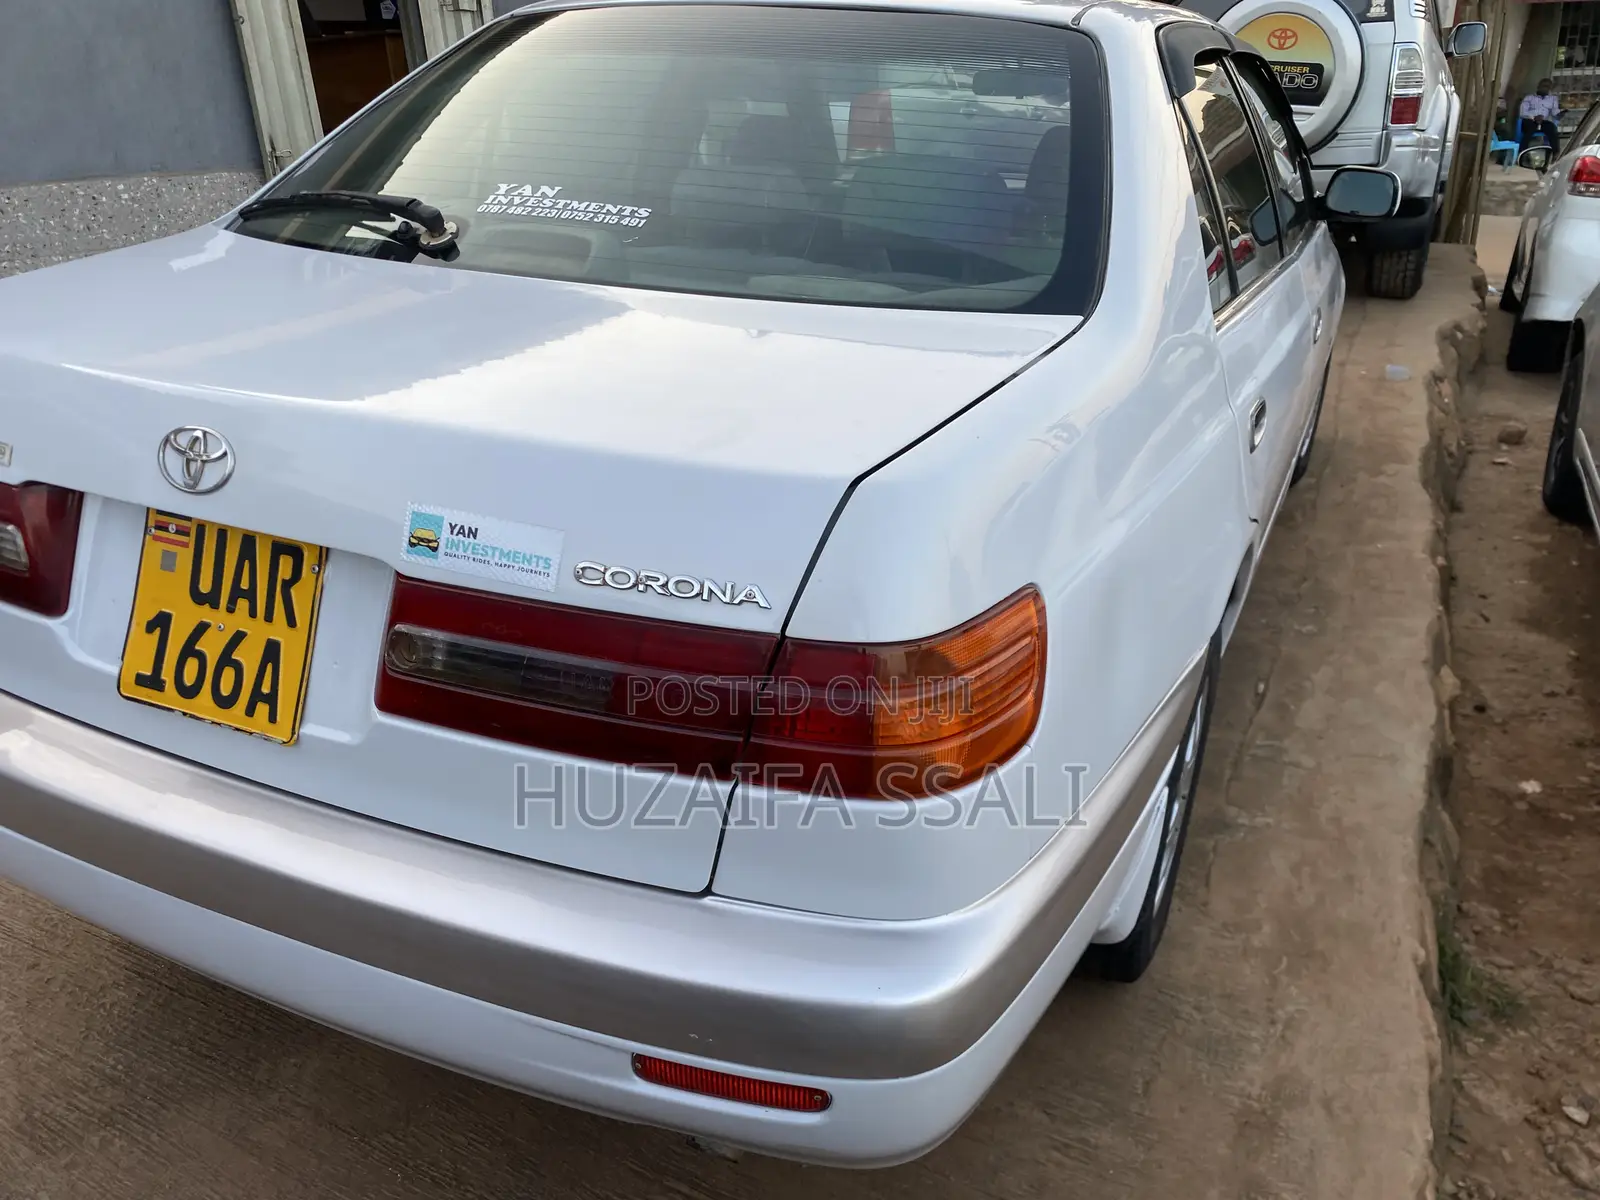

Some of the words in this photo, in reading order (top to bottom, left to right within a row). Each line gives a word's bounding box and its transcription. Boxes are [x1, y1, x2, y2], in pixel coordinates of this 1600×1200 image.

[495, 183, 563, 198] YAN
[484, 195, 652, 218] INVESTMENTS
[593, 213, 620, 225] 315
[620, 216, 647, 228] 491
[448, 522, 479, 540] YAN
[443, 551, 471, 562] QUALITY
[472, 556, 494, 567] RIDES,
[494, 562, 516, 571] HAPPY
[516, 567, 551, 578] JOURNEYS
[445, 537, 552, 570] INVESTMENTS
[189, 523, 305, 629] UAR
[574, 561, 772, 610] CORONA
[134, 609, 283, 725] 166A
